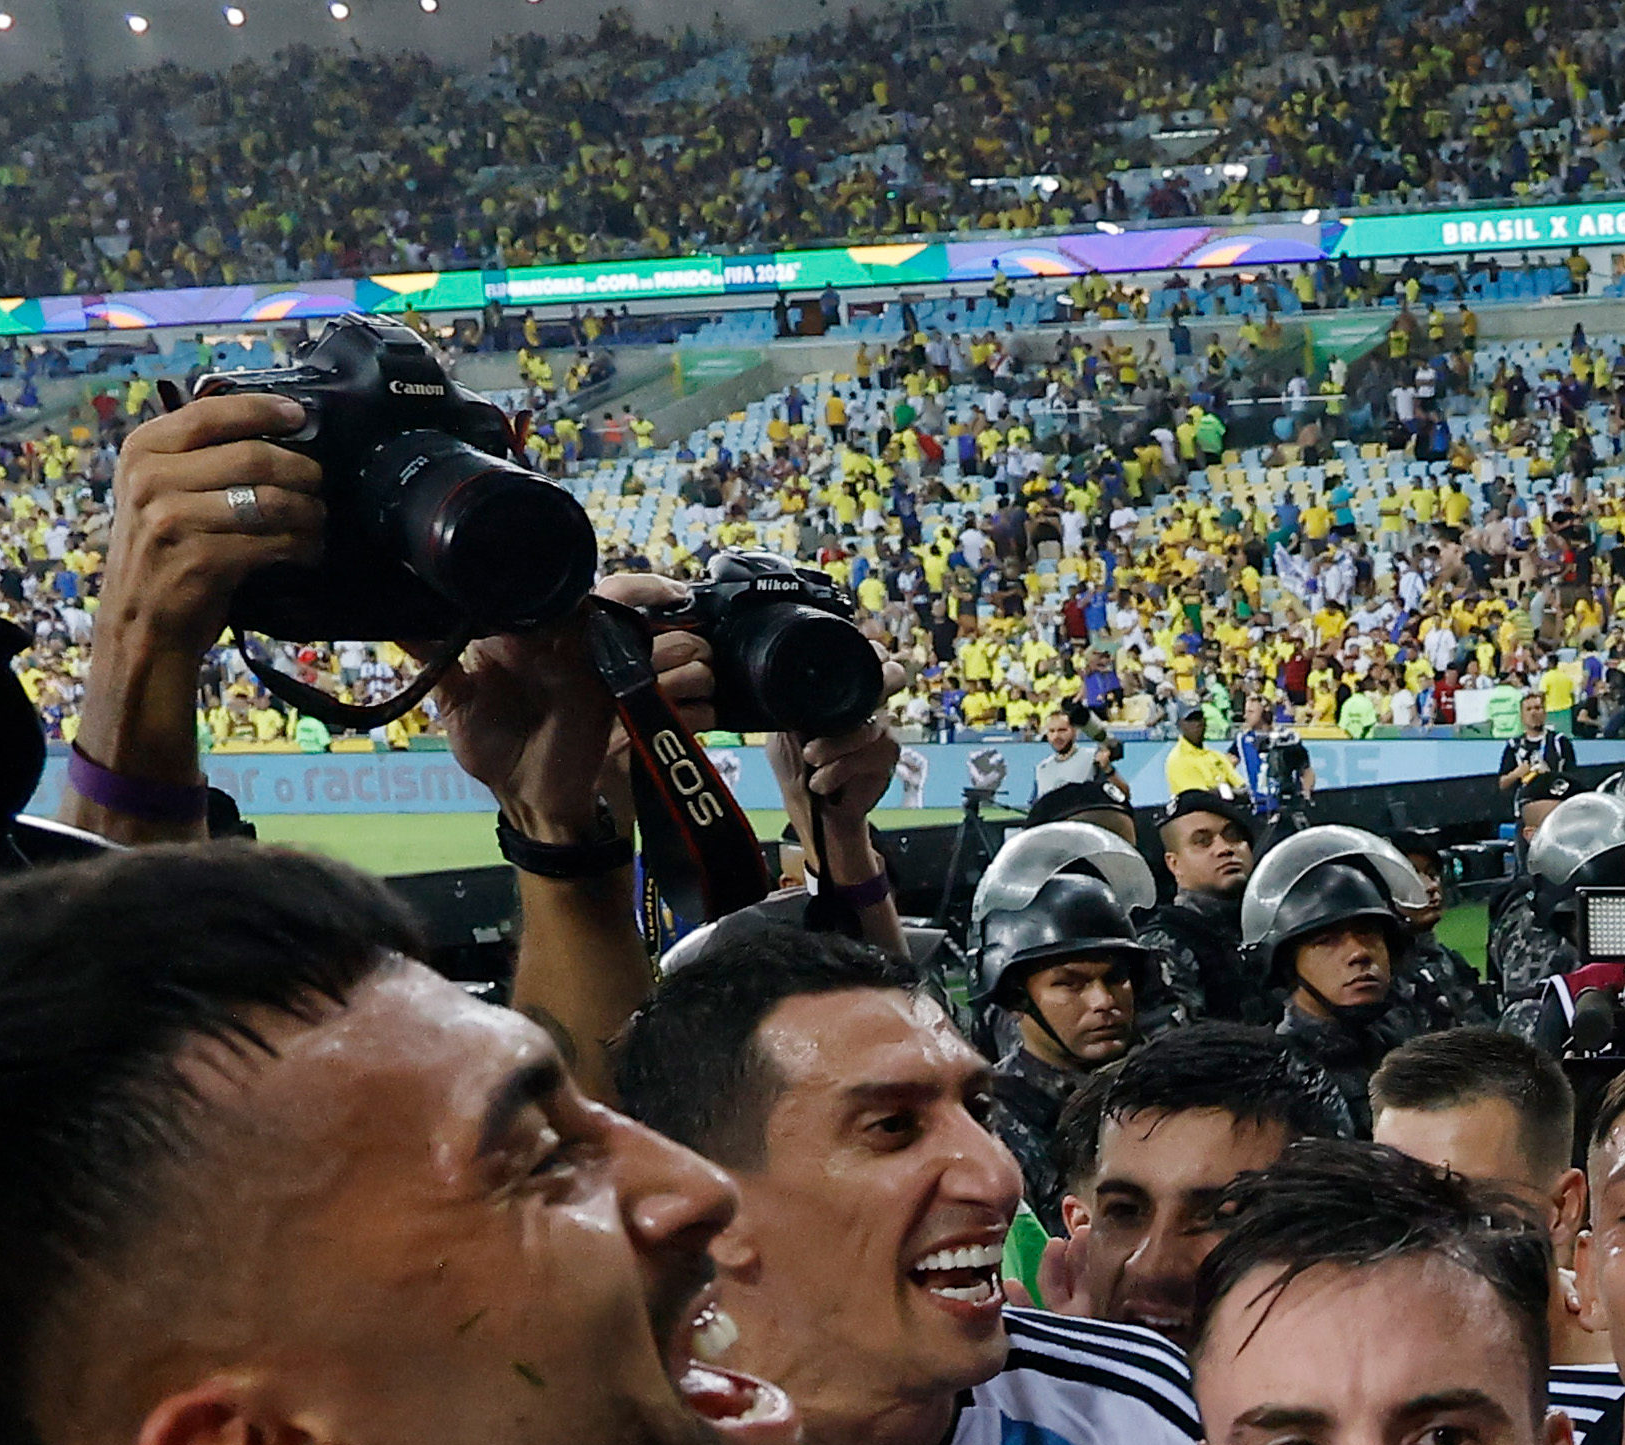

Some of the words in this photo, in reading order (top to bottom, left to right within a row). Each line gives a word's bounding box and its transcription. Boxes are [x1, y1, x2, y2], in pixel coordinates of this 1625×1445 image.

[1442, 218, 1540, 245] BRASIL
[1549, 215, 1569, 238] X
[389, 379, 445, 397] Canon
[756, 578, 800, 591] Nikon
[651, 729, 723, 827] EOS
